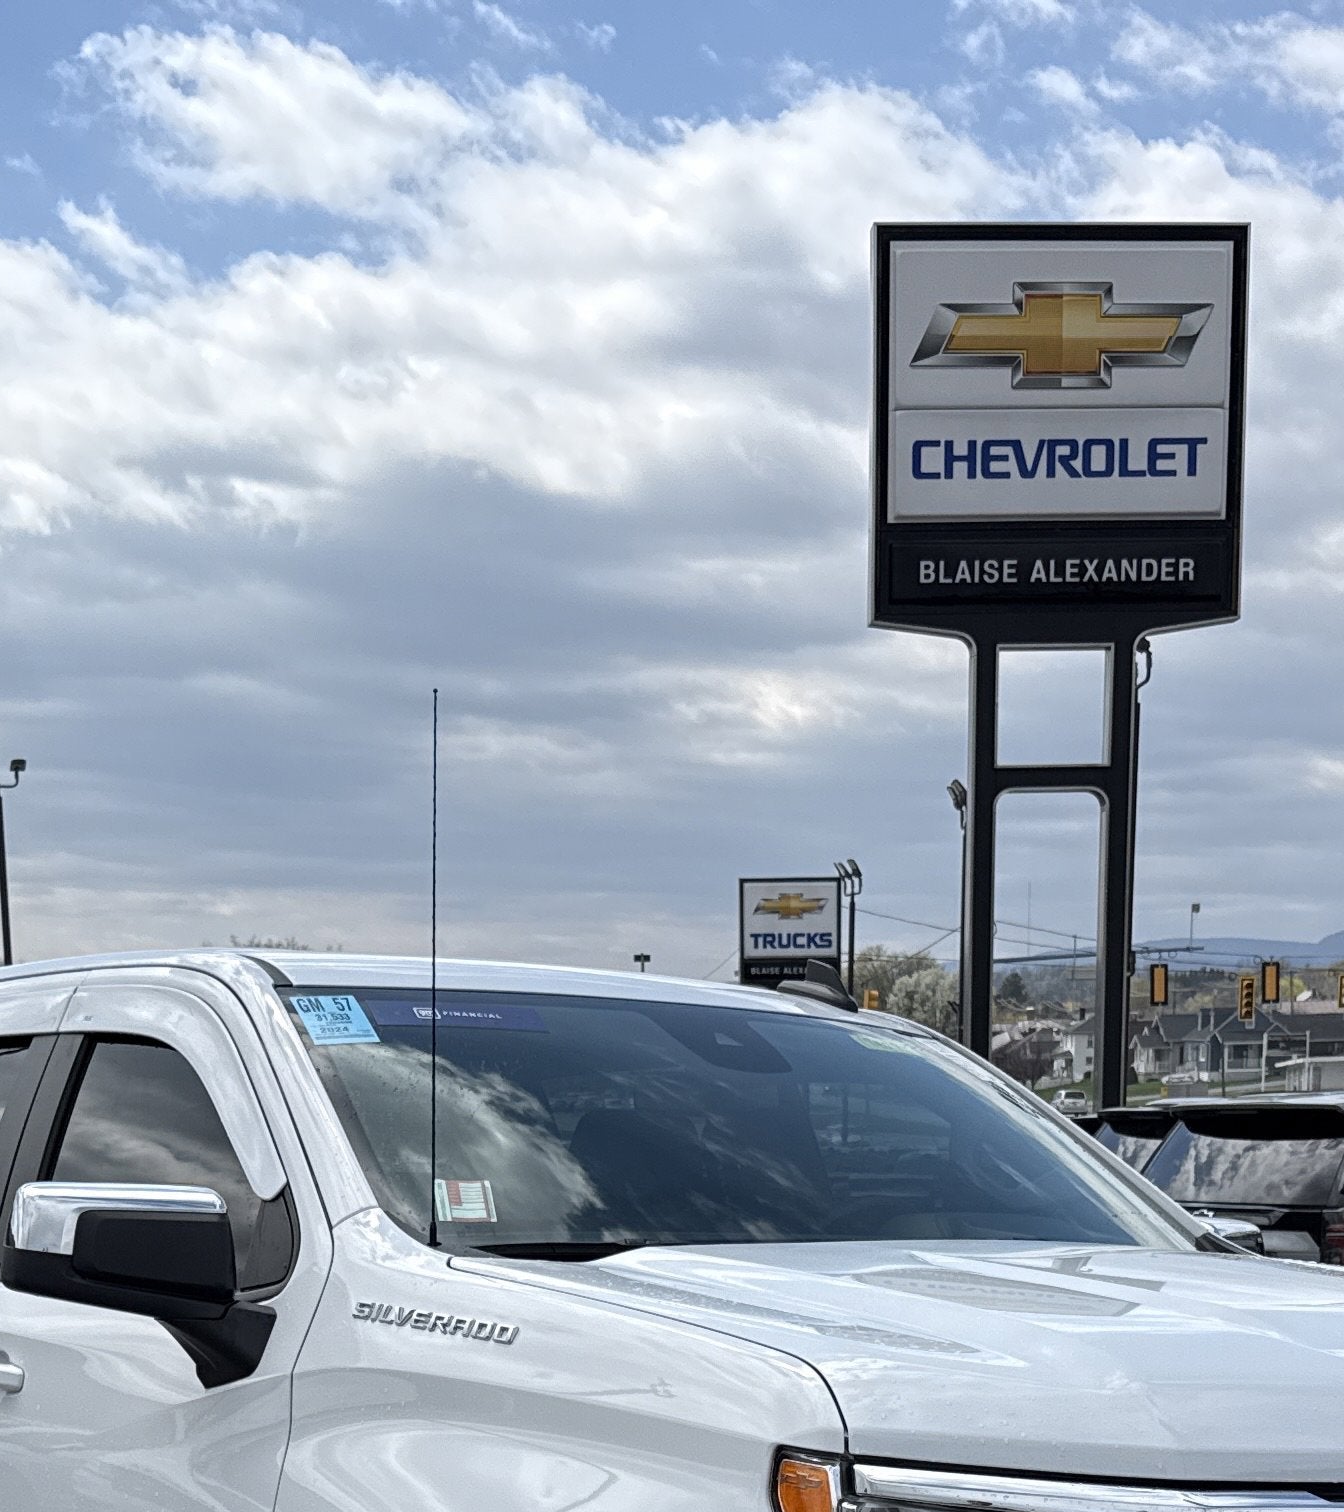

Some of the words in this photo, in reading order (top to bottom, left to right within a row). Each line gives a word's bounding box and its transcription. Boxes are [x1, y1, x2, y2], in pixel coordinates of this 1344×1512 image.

[912, 437, 1208, 480] CHEVROLET
[918, 559, 1018, 584] BLAISE
[1029, 558, 1196, 584] ALEXANDER
[750, 932, 833, 950] TRUCKS
[750, 966, 780, 975] BLAISE
[296, 998, 326, 1014] GM
[332, 997, 352, 1012] 57
[352, 1301, 520, 1346] SILVERADO
